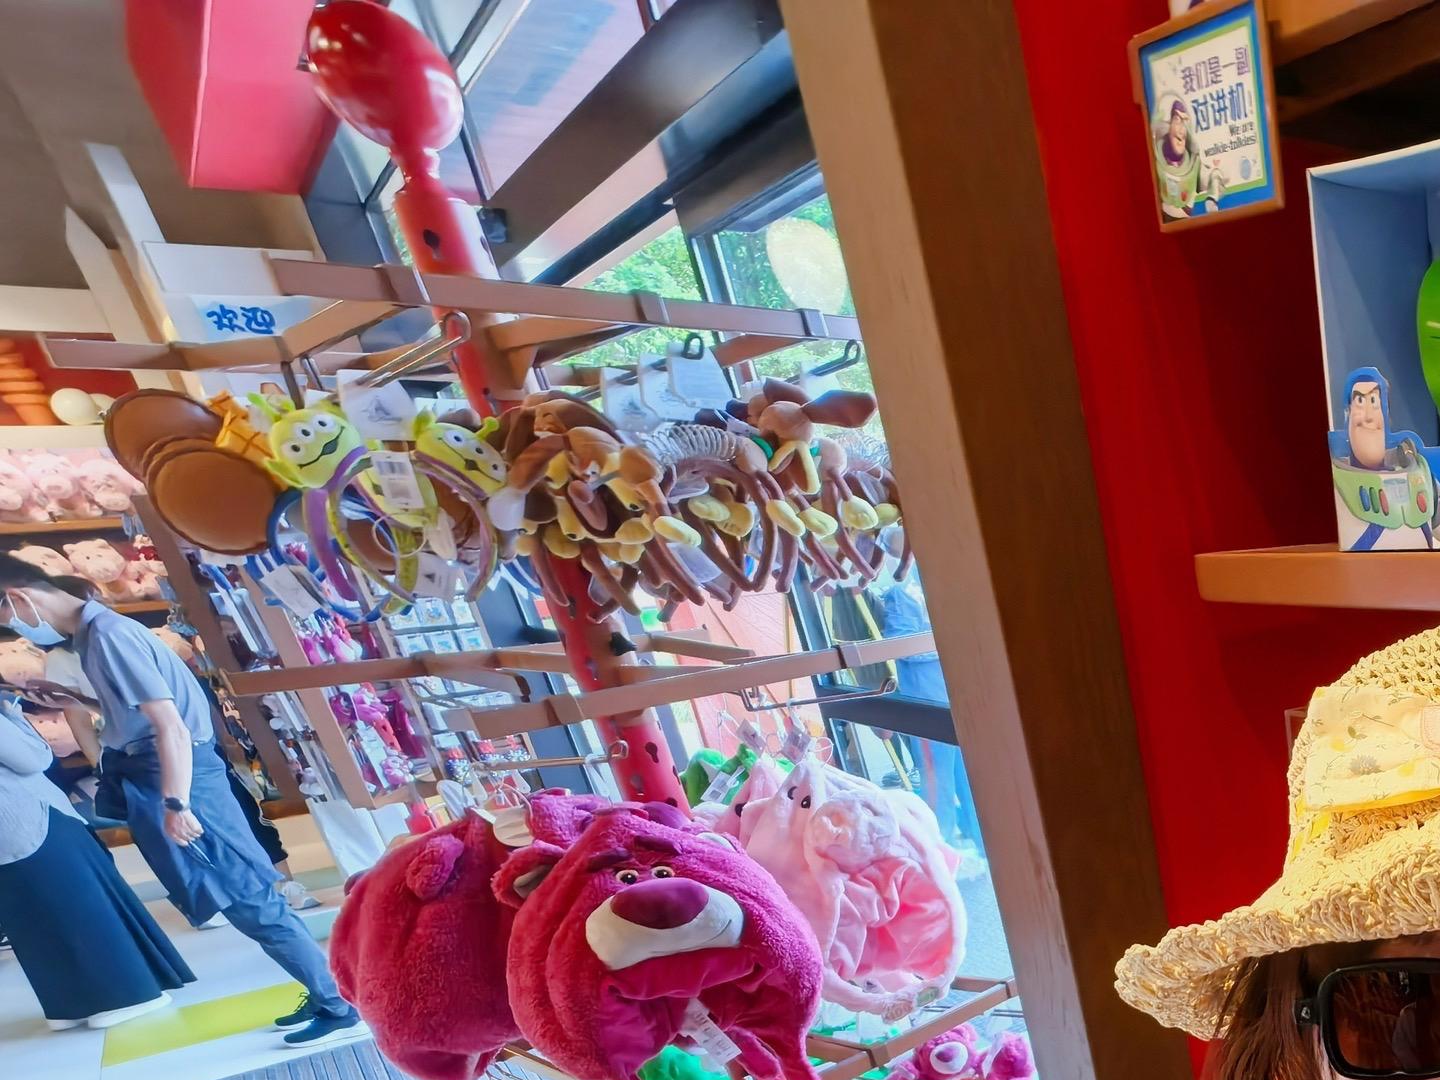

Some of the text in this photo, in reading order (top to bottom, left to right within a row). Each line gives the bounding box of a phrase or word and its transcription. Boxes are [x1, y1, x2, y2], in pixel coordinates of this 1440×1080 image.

[1181, 45, 1250, 94] 我们是一副
[206, 303, 276, 335] 欢迎
